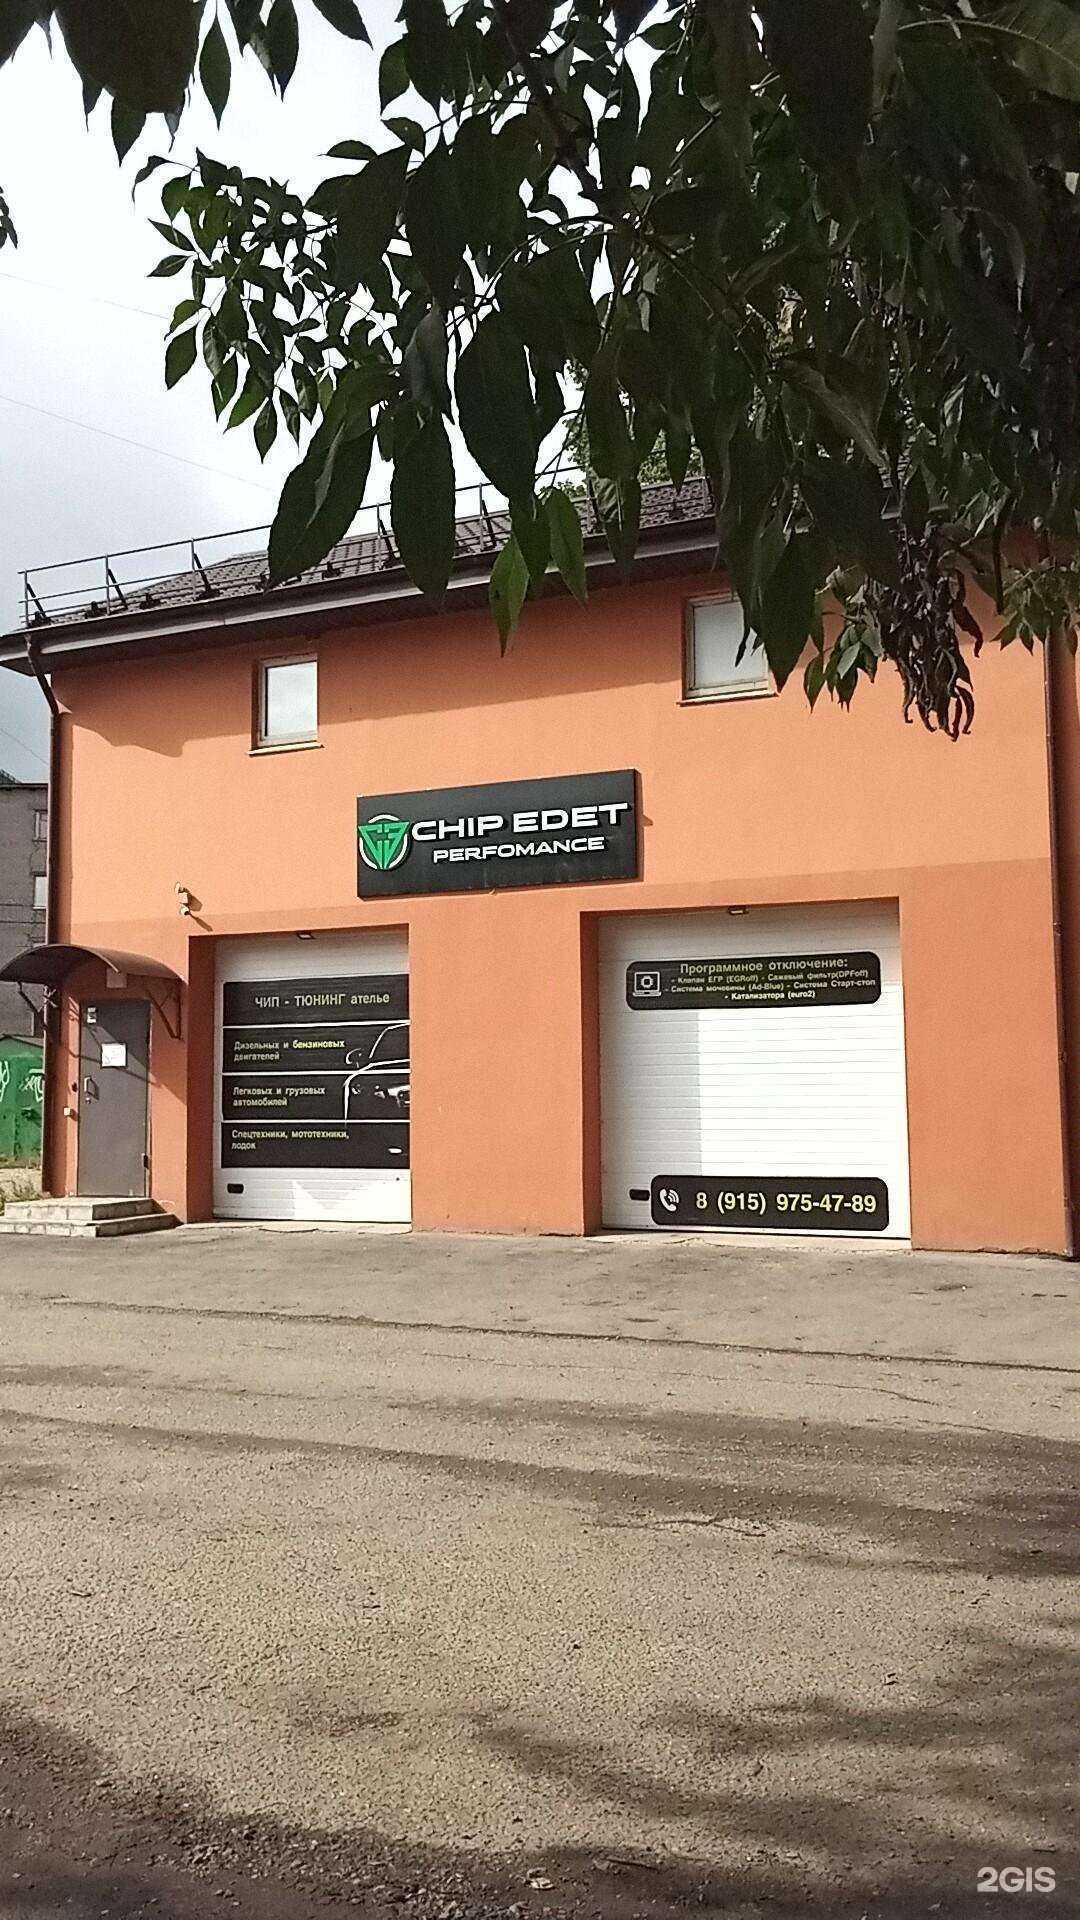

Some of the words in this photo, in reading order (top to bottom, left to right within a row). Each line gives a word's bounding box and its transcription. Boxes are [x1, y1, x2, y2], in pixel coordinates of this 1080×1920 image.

[411, 814, 503, 841] CHIP
[513, 802, 628, 833] EDET
[432, 836, 605, 864] PERFOMANCE
[680, 963, 763, 976] Программное
[768, 958, 848, 971] отключение:
[768, 973, 803, 981] Сажевый
[671, 985, 703, 993] Система
[749, 983, 784, 992] (Ad-Blue)
[793, 981, 828, 989] Система
[830, 979, 876, 988] Старт-стоп
[254, 996, 280, 1009] ЧИП
[294, 993, 346, 1007] ТЮНИНГ
[350, 992, 390, 1005] ателье
[731, 991, 785, 1000] Катализатора
[788, 990, 816, 1000] (euro2)
[234, 1041, 280, 1051] Дизельных
[292, 1039, 345, 1049] бензиновых
[234, 1052, 280, 1062] двигателей
[233, 1086, 273, 1096] Легковых
[285, 1087, 326, 1097] грузовых
[233, 1097, 288, 1107] автомобилей
[231, 1129, 289, 1140] Спецтехники,
[291, 1130, 350, 1140] мототехники,
[231, 1141, 256, 1150] лодок
[696, 1192, 708, 1209] 8
[717, 1191, 766, 1215] (915)
[776, 1193, 877, 1213] 975-47-89
